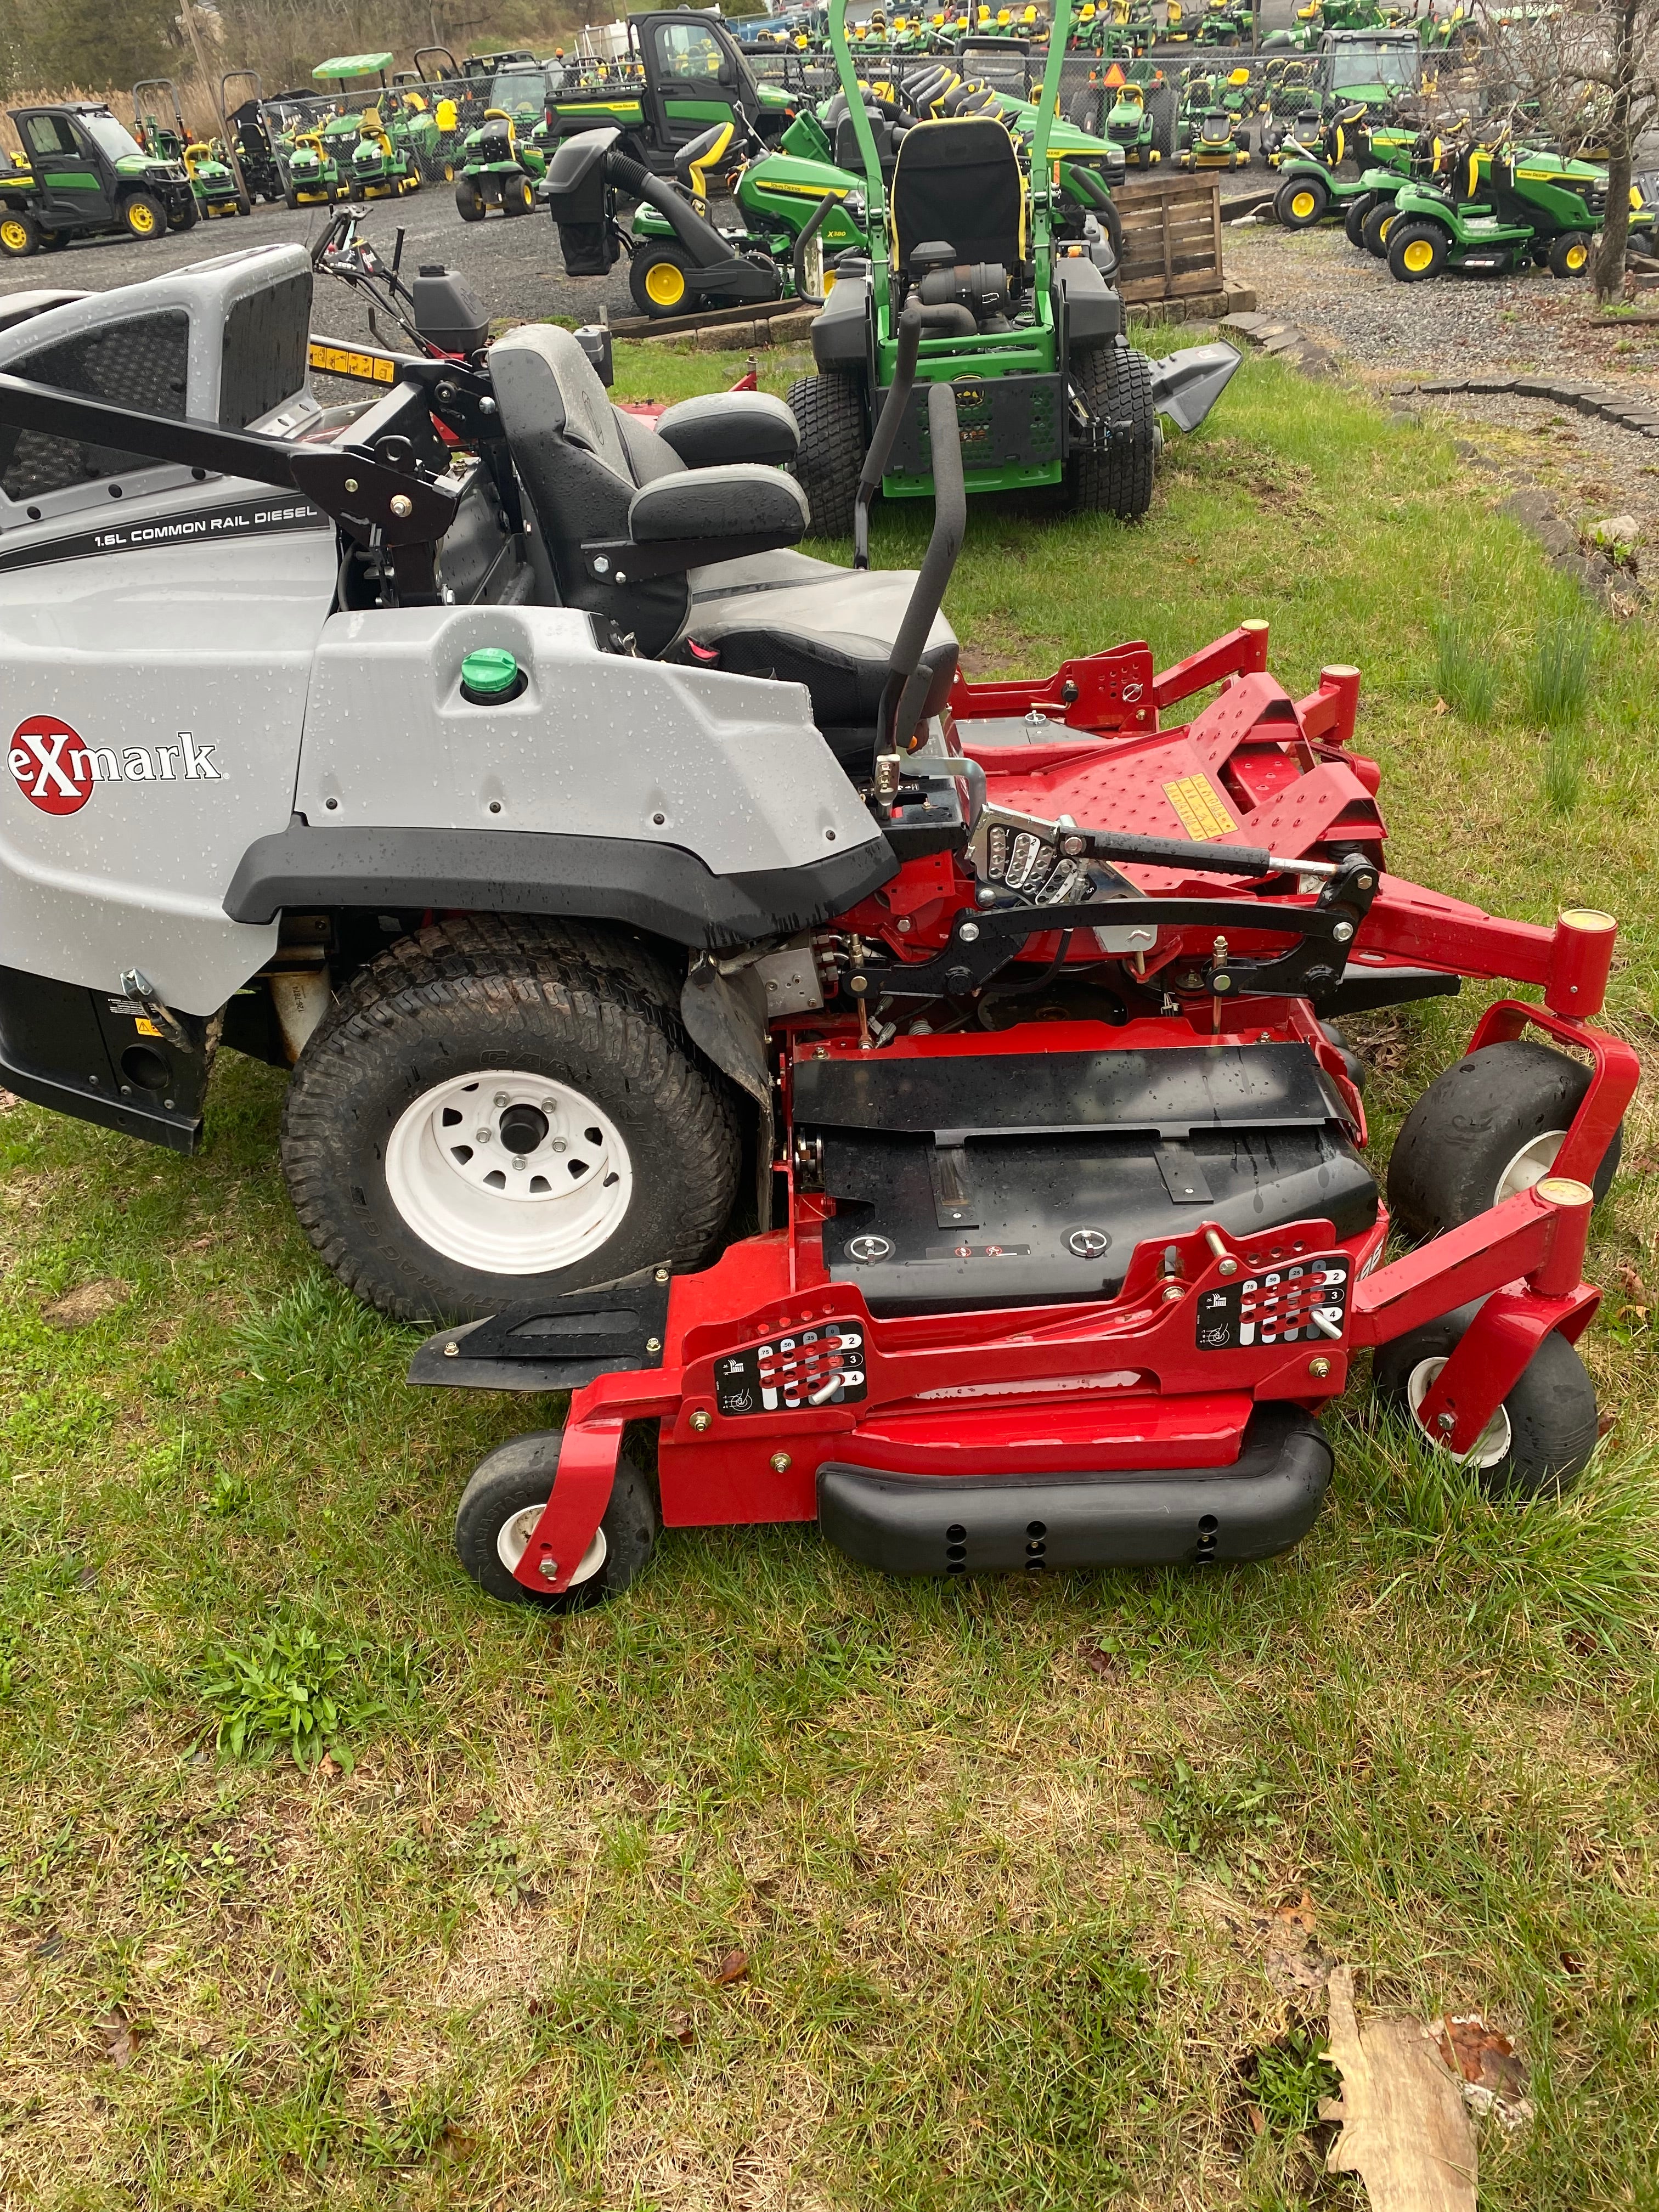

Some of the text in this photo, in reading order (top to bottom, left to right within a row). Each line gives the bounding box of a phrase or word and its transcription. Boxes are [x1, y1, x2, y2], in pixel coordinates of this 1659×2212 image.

[94, 505, 318, 547] 1.6L COMMON RAIL DIESEL
[377, 1245, 458, 1297] TRAC
[459, 1291, 515, 1310] LTI
[850, 1355, 857, 1363] 3
[851, 1374, 857, 1382] 4
